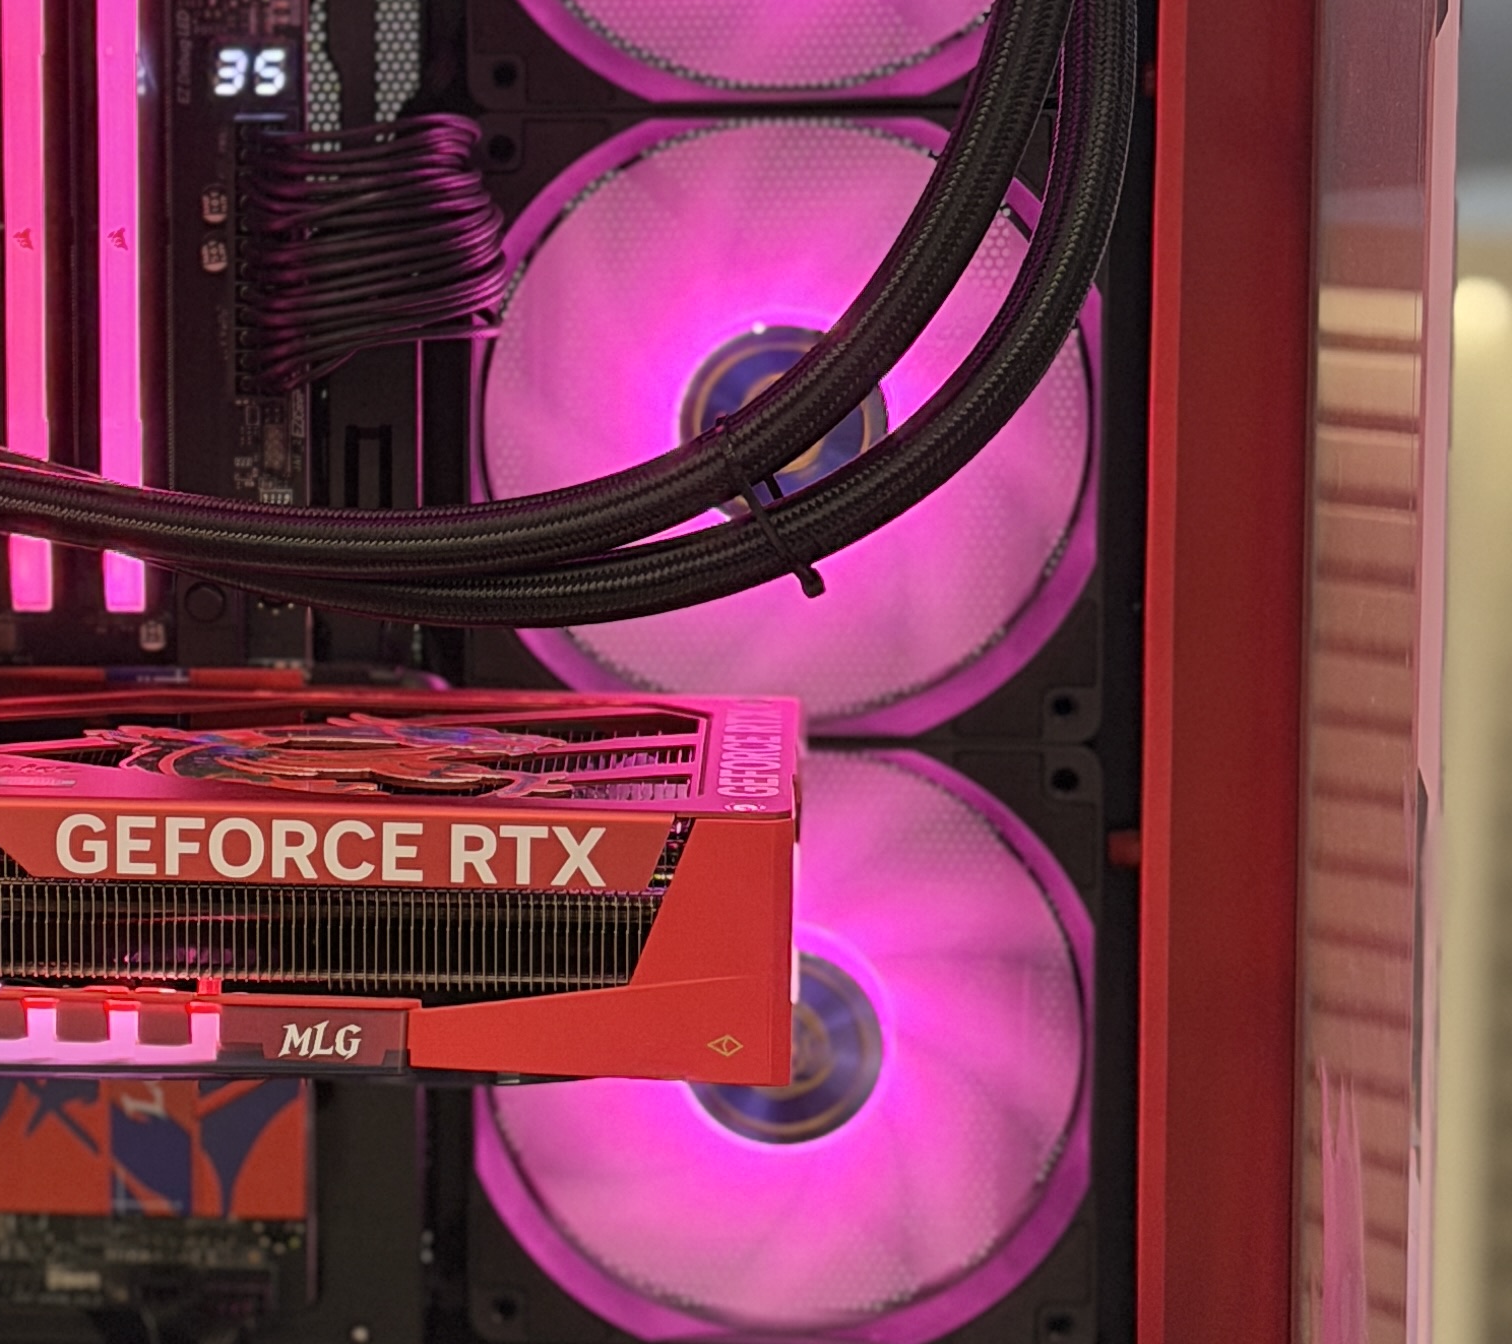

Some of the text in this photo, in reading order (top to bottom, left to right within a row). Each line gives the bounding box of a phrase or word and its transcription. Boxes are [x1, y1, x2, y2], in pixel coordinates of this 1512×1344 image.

[214, 49, 286, 96] 35
[717, 707, 783, 797] GEFORCE RTX
[56, 813, 608, 889] GEFORCE RTX
[278, 1020, 363, 1060] MLG
